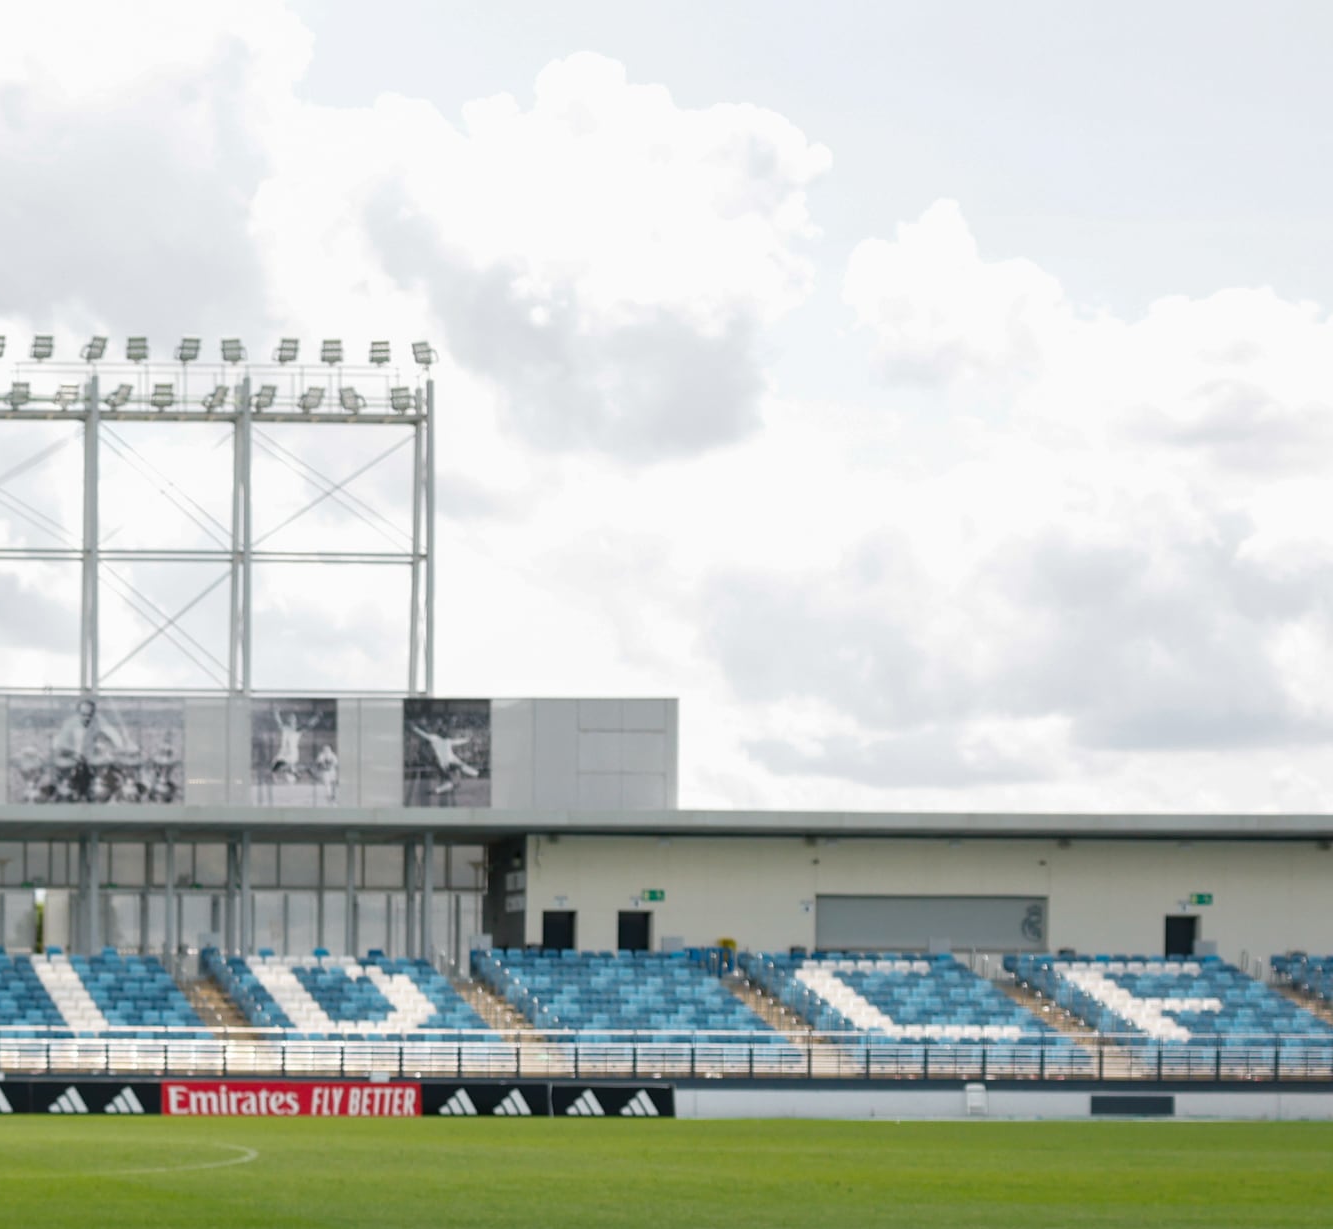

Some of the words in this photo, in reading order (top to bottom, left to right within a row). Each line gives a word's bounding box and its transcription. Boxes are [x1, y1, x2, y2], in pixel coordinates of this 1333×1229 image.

[167, 1085, 300, 1115] Emirates
[311, 1087, 347, 1116] FLY
[348, 1087, 416, 1116] BETTER
